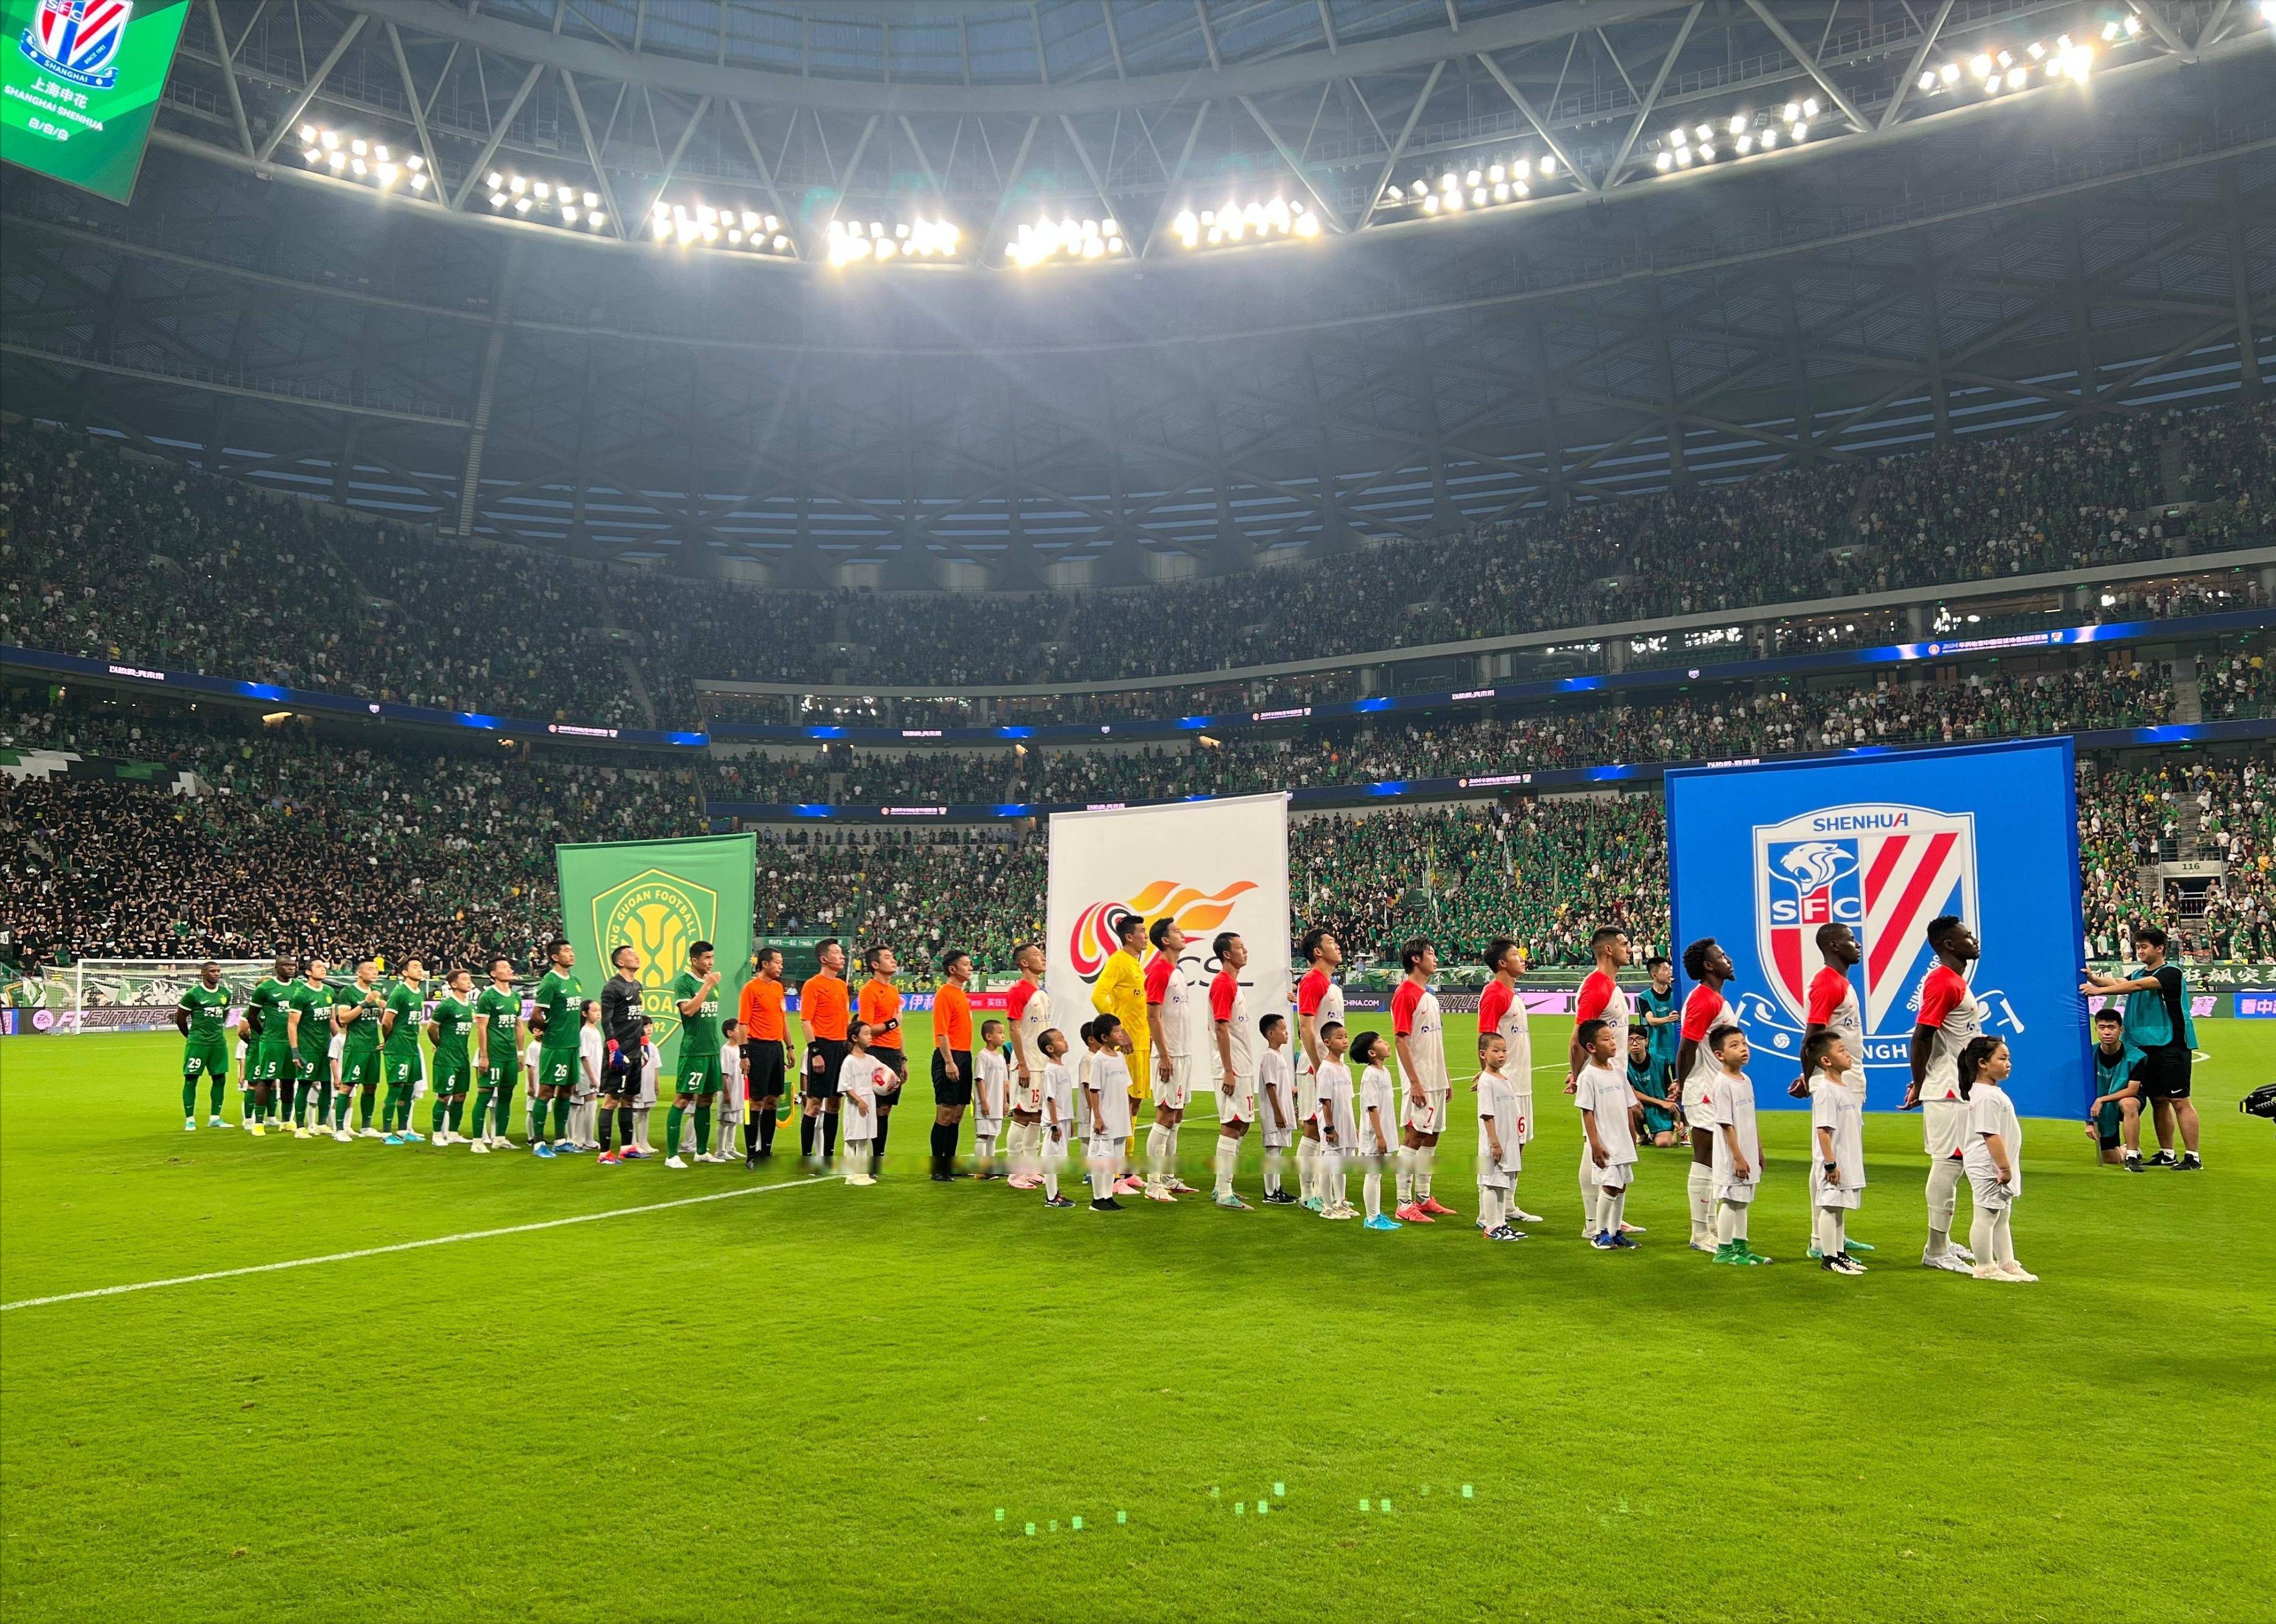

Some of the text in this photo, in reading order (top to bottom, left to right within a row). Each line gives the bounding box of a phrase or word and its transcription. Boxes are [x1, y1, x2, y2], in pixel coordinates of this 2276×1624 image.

[44, 60, 88, 83] SHANGHAI
[30, 76, 88, 109] 上海申花
[4, 85, 103, 131] SHANGHAI SHENHUA
[1813, 813, 1908, 832] SHENHUA
[617, 890, 651, 921] GUOAN
[655, 889, 697, 936] FOOTBALL
[1772, 897, 1861, 921] SFC
[2241, 999, 2276, 1014] 看中
[654, 1021, 666, 1033] 92
[188, 1058, 201, 1069] 29
[255, 1065, 260, 1075] 8
[268, 1061, 276, 1073] 5
[306, 1063, 314, 1074] 9
[353, 1064, 361, 1076] 4
[398, 1063, 408, 1076] 21
[554, 1064, 567, 1077] 26
[448, 1075, 455, 1086] 6
[490, 1067, 500, 1080] 11
[688, 1072, 703, 1086] 27
[622, 1075, 626, 1088] 1
[1031, 1089, 1040, 1103] 15
[1178, 1084, 1182, 1099] 4
[1428, 1107, 1434, 1123] 7
[1517, 1116, 1525, 1133] 6
